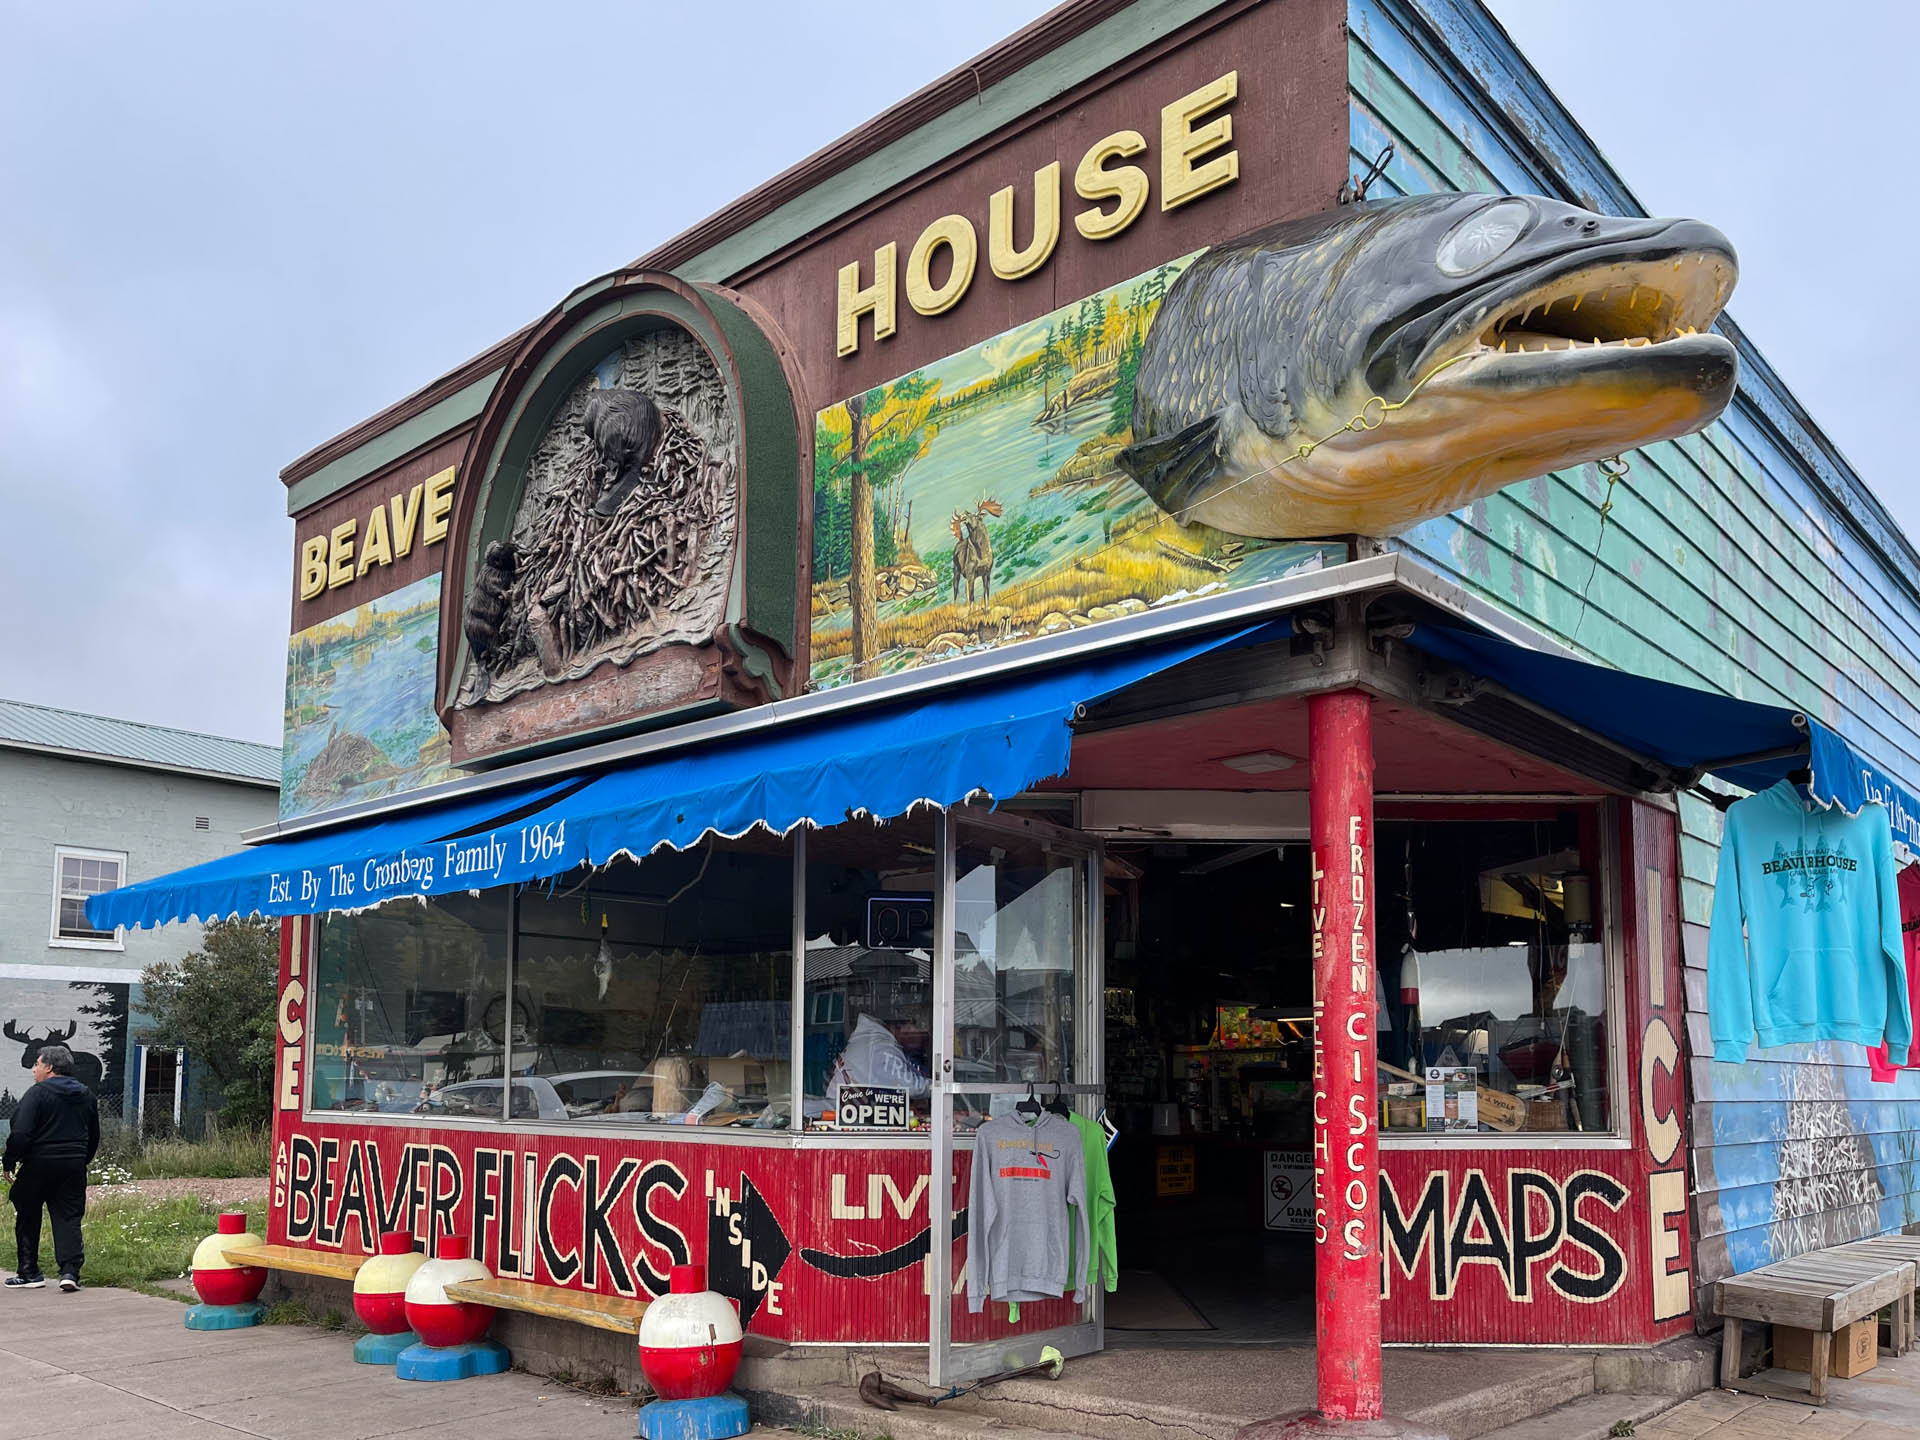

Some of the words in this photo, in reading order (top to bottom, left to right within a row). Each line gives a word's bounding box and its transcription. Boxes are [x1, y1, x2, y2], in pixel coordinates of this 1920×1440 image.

[837, 70, 1239, 358] HOUSE
[301, 465, 456, 600] BEAVE
[268, 873, 292, 903] Est.
[301, 870, 321, 908] By
[329, 864, 355, 897] The
[363, 849, 434, 890] Cronberg
[444, 834, 507, 879] Family
[520, 819, 566, 864] 1964
[1312, 851, 1326, 958] LIVE
[1350, 816, 1367, 992] FROZEN
[279, 915, 304, 1110] ICE
[841, 1104, 905, 1125] OPEN
[842, 1091, 863, 1102] Come
[875, 1094, 904, 1104] WE'RE
[1271, 1153, 1314, 1163] DANGE
[1313, 969, 1328, 1244] LEECHES
[1344, 1012, 1368, 1261] CISCOS
[1641, 866, 1691, 1322] ICE
[275, 1141, 288, 1208] AND
[287, 1134, 464, 1258] BEAVER
[471, 1147, 691, 1300] FLICKS
[1287, 1207, 1314, 1218] DAN
[1378, 1168, 1631, 1303] MAPS
[705, 1169, 783, 1316] INSIDE
